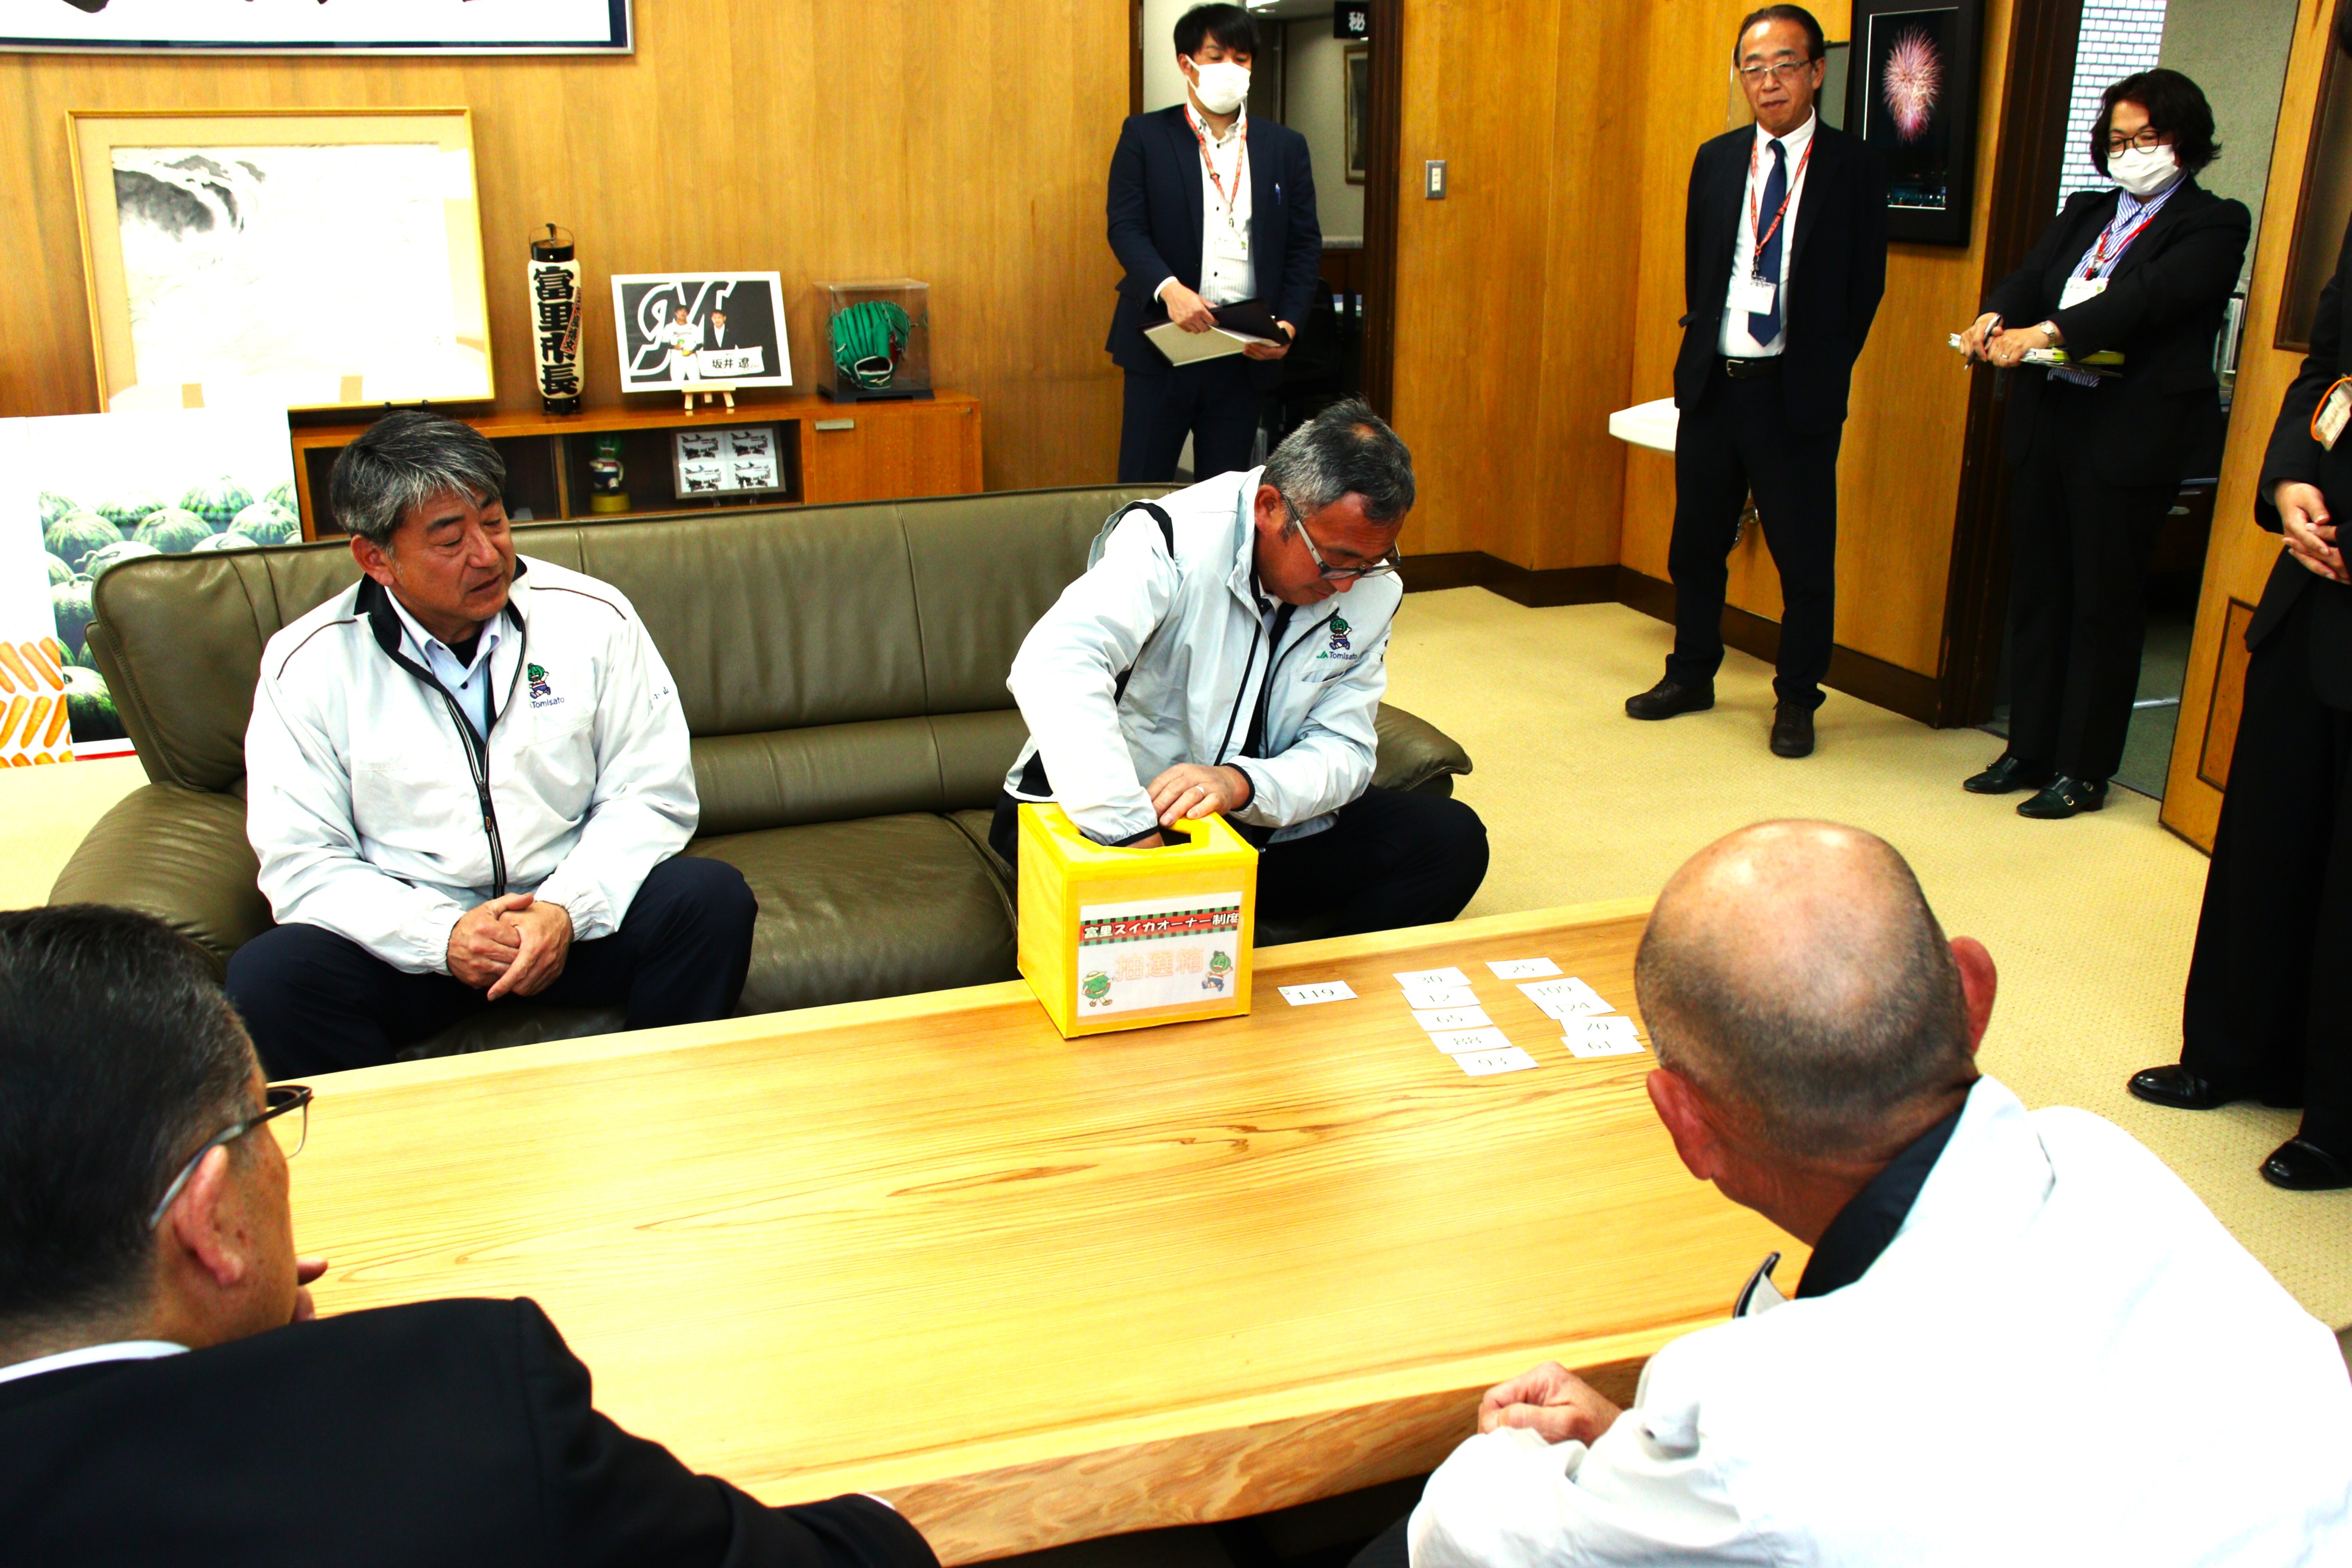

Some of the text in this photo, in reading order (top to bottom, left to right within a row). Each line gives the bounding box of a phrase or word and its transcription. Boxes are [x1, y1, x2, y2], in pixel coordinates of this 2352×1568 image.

[534, 266, 579, 395] 富里市長
[712, 358, 734, 368] 坂井
[1329, 651, 1357, 660] Tomisato
[532, 697, 565, 708] Tomisato
[1083, 912, 1239, 939] 富里スイカオーナー制度
[1115, 947, 1205, 982] 抽選箱
[1416, 975, 1443, 984] 30
[1297, 989, 1334, 999] 119
[1537, 985, 1572, 996] 109
[1428, 994, 1449, 1002] 12
[1555, 1002, 1591, 1013] 124
[1436, 1015, 1463, 1023] 65
[1454, 1036, 1482, 1045] 88
[1588, 1041, 1612, 1050] 61
[1478, 1057, 1507, 1067] 93
